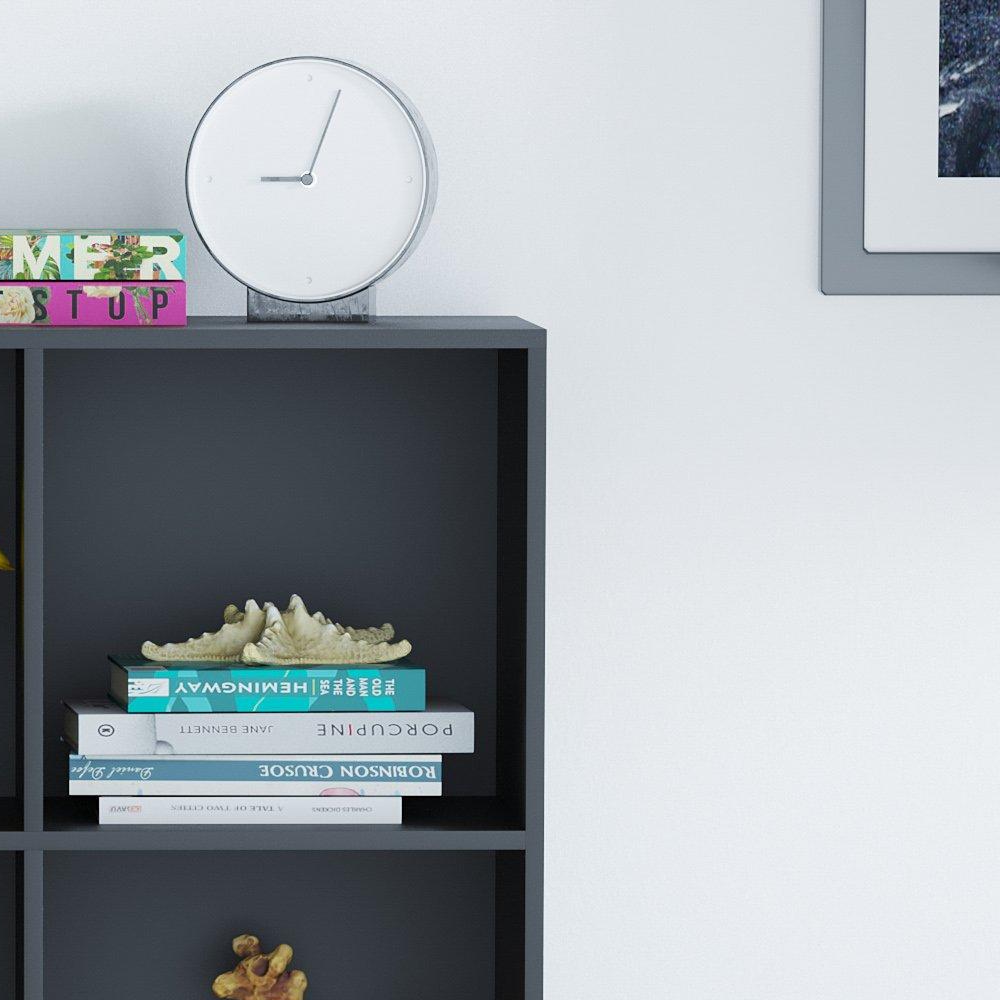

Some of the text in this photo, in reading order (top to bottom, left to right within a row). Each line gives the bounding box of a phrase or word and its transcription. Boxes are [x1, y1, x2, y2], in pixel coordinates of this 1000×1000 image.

[33, 288, 170, 321] STOP
[175, 682, 307, 694] HEMINGWAY
[319, 679, 330, 696] SEA
[332, 678, 343, 696] THE
[345, 678, 356, 696] AND
[358, 678, 369, 696] MAN
[371, 678, 382, 696] OLD
[385, 678, 395, 696] THE
[179, 725, 274, 734] JANE BENNETT
[316, 723, 453, 736] PORCUPINE
[71, 762, 154, 780] Daniel Defoe
[259, 765, 436, 779] ROBINSON CRUSOE
